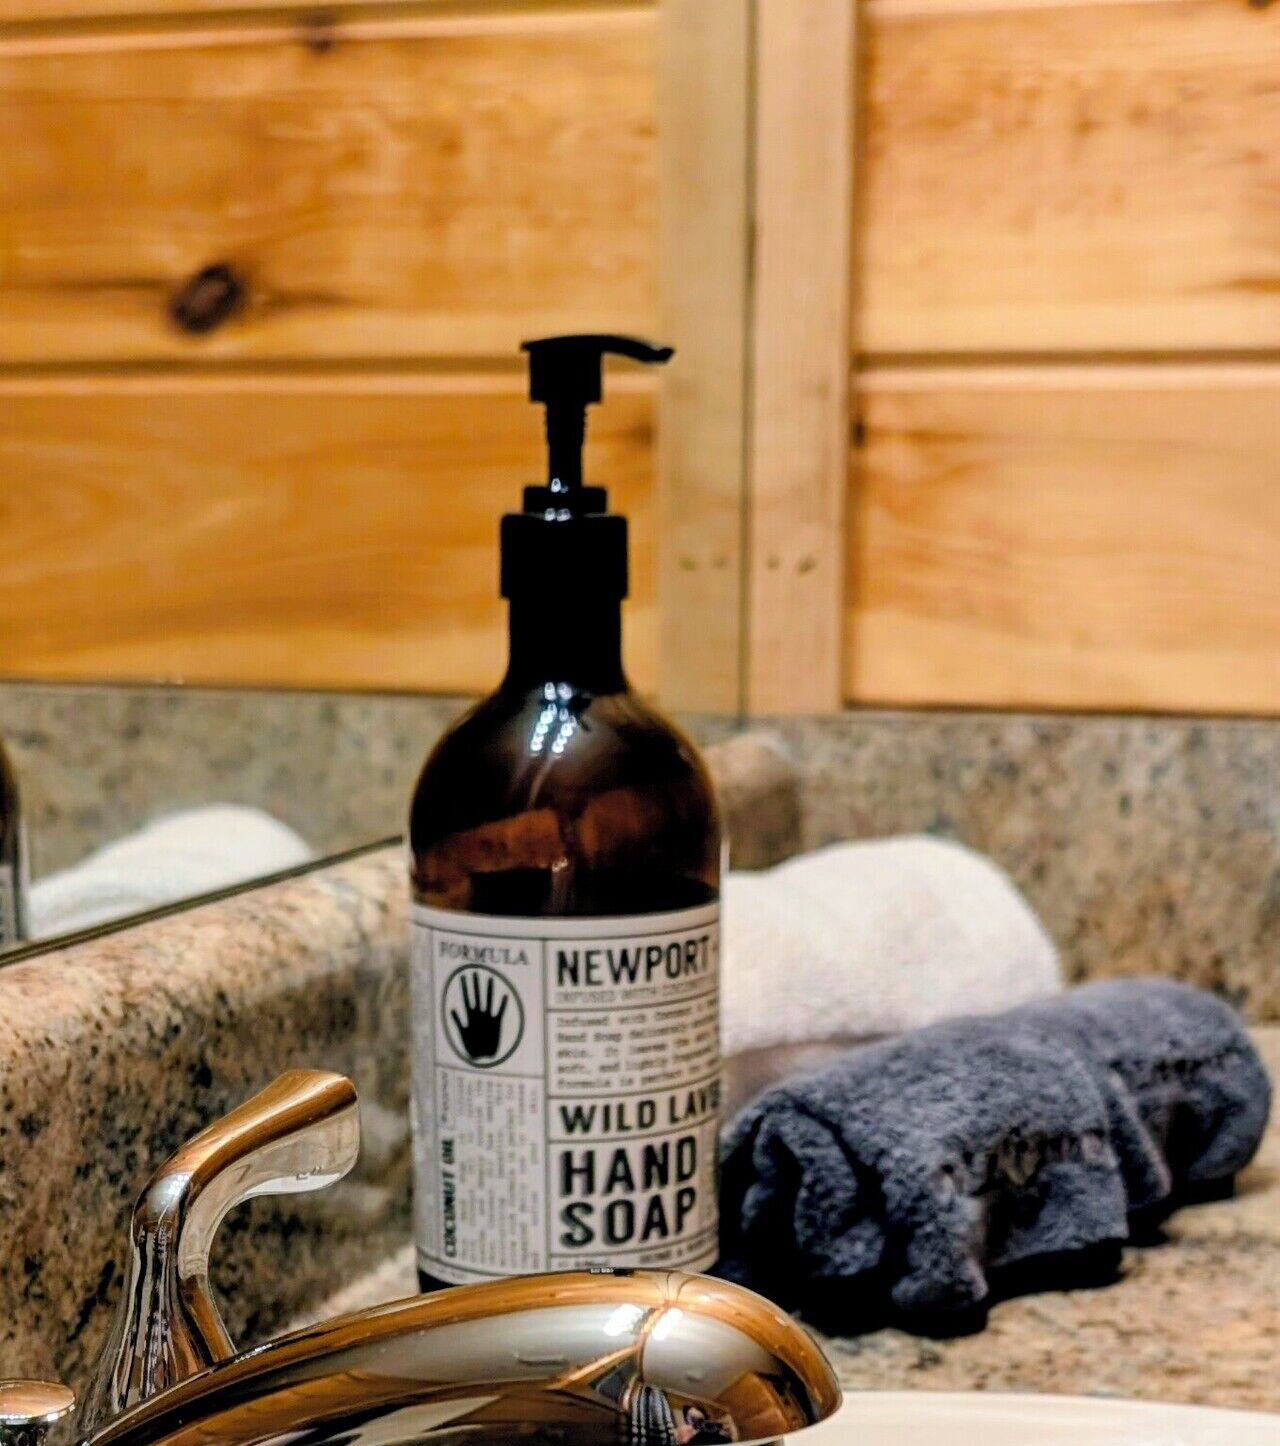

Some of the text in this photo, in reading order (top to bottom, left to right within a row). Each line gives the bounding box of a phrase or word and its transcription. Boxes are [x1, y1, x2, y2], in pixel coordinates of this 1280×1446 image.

[439, 941, 529, 967] FORMULA
[556, 936, 711, 987] NEWPORT
[560, 1099, 657, 1136] WILD
[559, 1136, 697, 1198] HAND
[558, 1187, 698, 1249] SOAP
